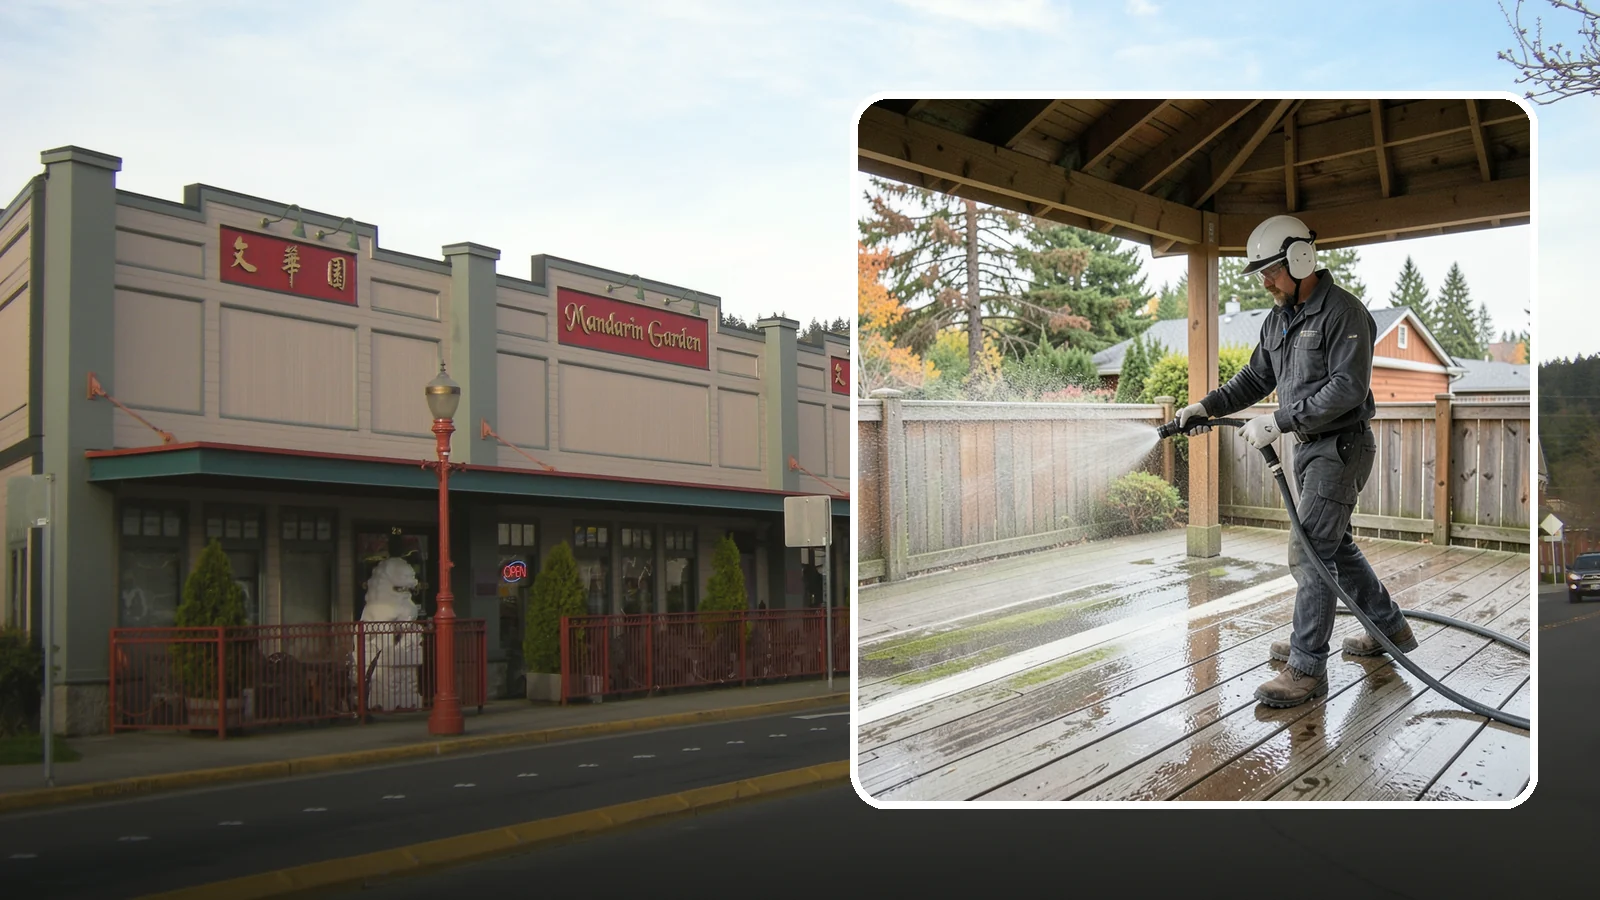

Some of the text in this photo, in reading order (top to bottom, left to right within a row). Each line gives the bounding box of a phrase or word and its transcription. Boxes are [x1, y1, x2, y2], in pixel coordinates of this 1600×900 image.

[564, 302, 701, 352] Mandarin Garden
[503, 565, 527, 578] OPEN
